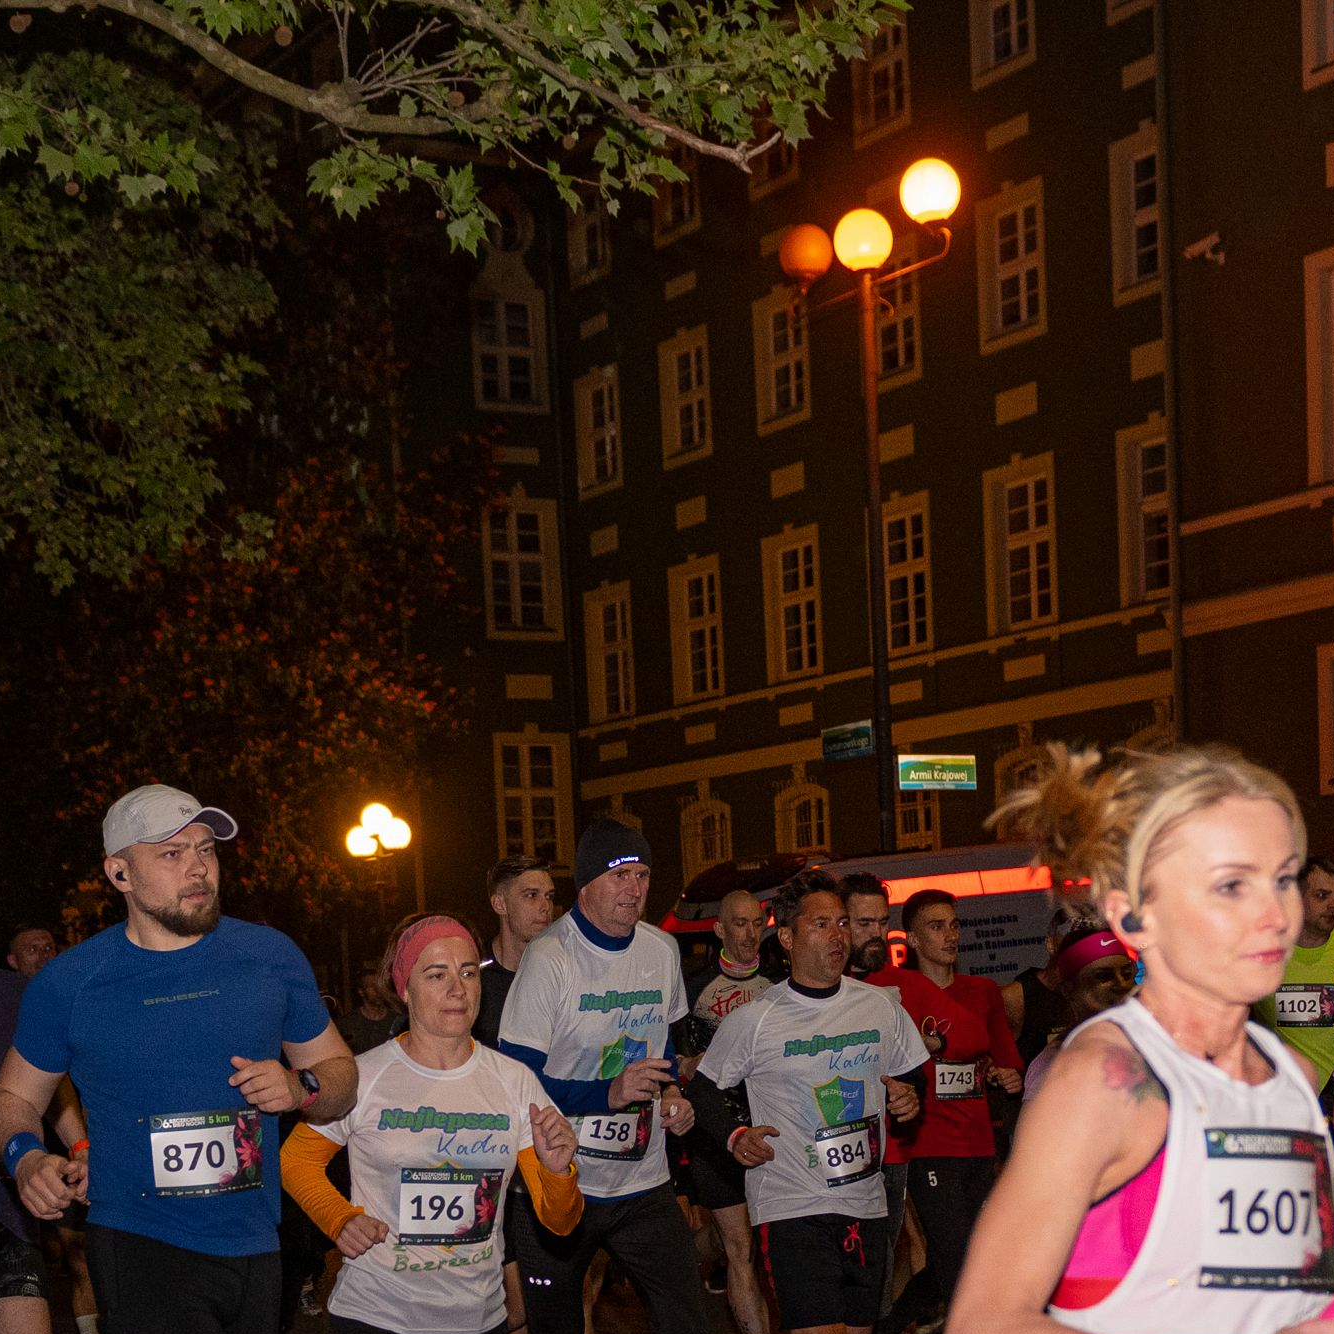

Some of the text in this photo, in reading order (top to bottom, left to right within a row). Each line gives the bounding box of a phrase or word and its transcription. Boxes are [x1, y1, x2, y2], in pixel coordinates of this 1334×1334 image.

[909, 770, 967, 782] Armii Krajowej
[975, 928, 1005, 939] Stacja
[969, 962, 1018, 976] Szczecinie
[143, 989, 219, 1005] BRUBECK
[1278, 999, 1317, 1013] 1102
[618, 1006, 664, 1030] Kadra
[828, 1046, 879, 1071] Kadra
[939, 1071, 973, 1086] 1743
[208, 1116, 215, 1124] 5
[216, 1114, 230, 1123] km
[377, 1105, 510, 1134] Najlepsza
[589, 1118, 631, 1142] 158
[436, 1133, 510, 1156] Kadra
[826, 1140, 866, 1168] 884
[163, 1140, 226, 1173] 870
[453, 1173, 459, 1181] 5
[460, 1172, 474, 1181] km
[927, 1170, 938, 1187] 5
[410, 1195, 465, 1221] 196
[1218, 1188, 1312, 1235] 1607
